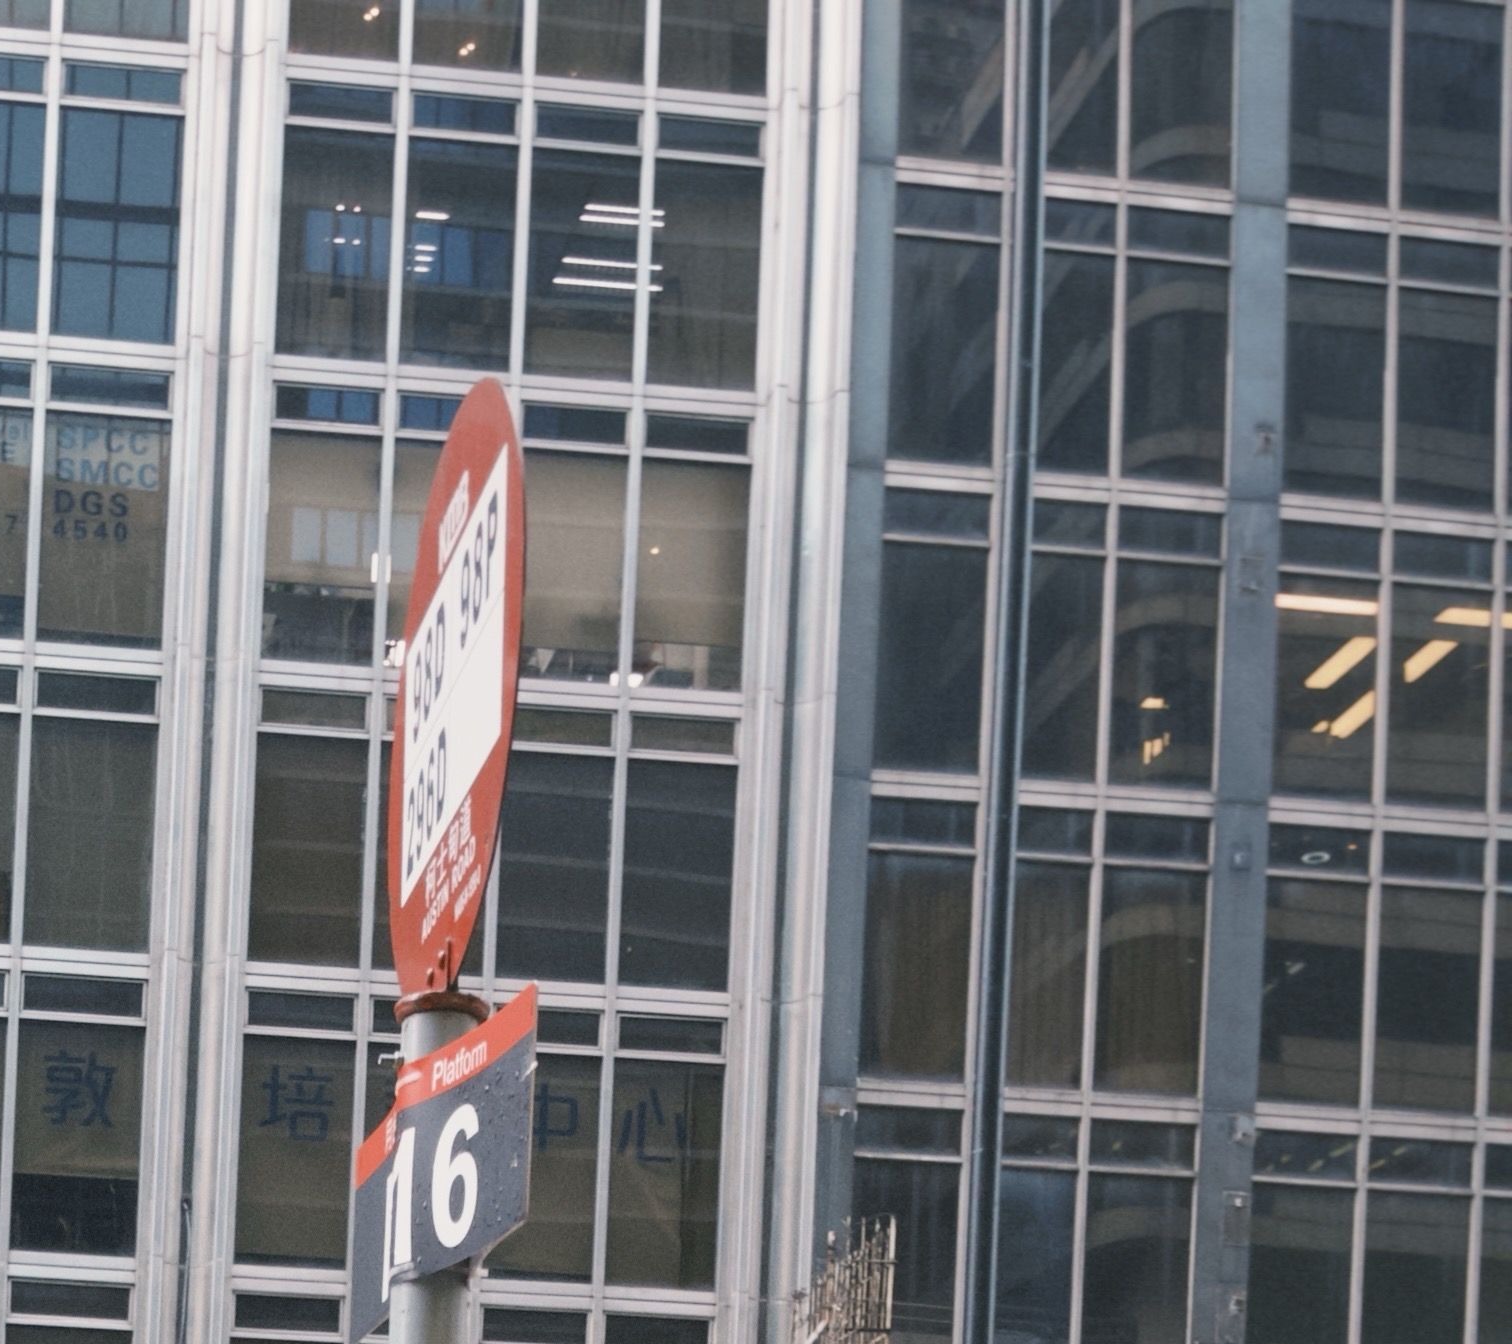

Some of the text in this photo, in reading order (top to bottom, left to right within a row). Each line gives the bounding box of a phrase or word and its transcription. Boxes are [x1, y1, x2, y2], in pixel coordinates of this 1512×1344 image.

[57, 426, 150, 456] SPCC
[56, 457, 158, 489] SMCC
[52, 519, 128, 543] 4540
[54, 489, 129, 518] DGS
[460, 489, 498, 650] 98P
[413, 602, 445, 744] 98D
[406, 727, 446, 882] 296D
[451, 835, 476, 893] ROAD
[431, 1040, 488, 1092] Platform
[391, 1102, 480, 1267] 16
